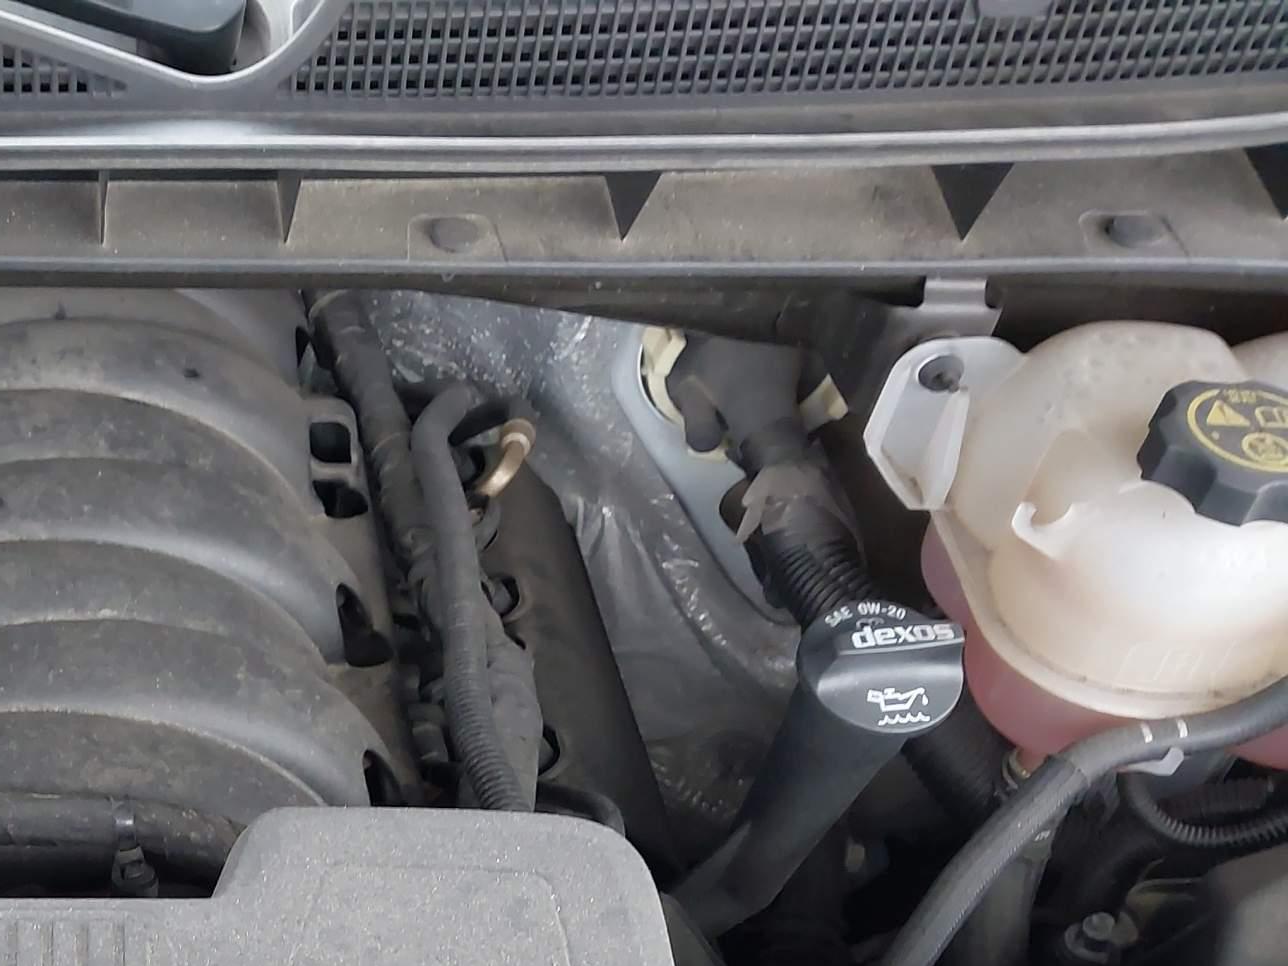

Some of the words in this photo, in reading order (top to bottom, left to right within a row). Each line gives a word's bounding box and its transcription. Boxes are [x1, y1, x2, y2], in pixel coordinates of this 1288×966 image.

[825, 606, 853, 627] SAE
[857, 601, 906, 620] 0W-20
[851, 624, 955, 649] dexos
